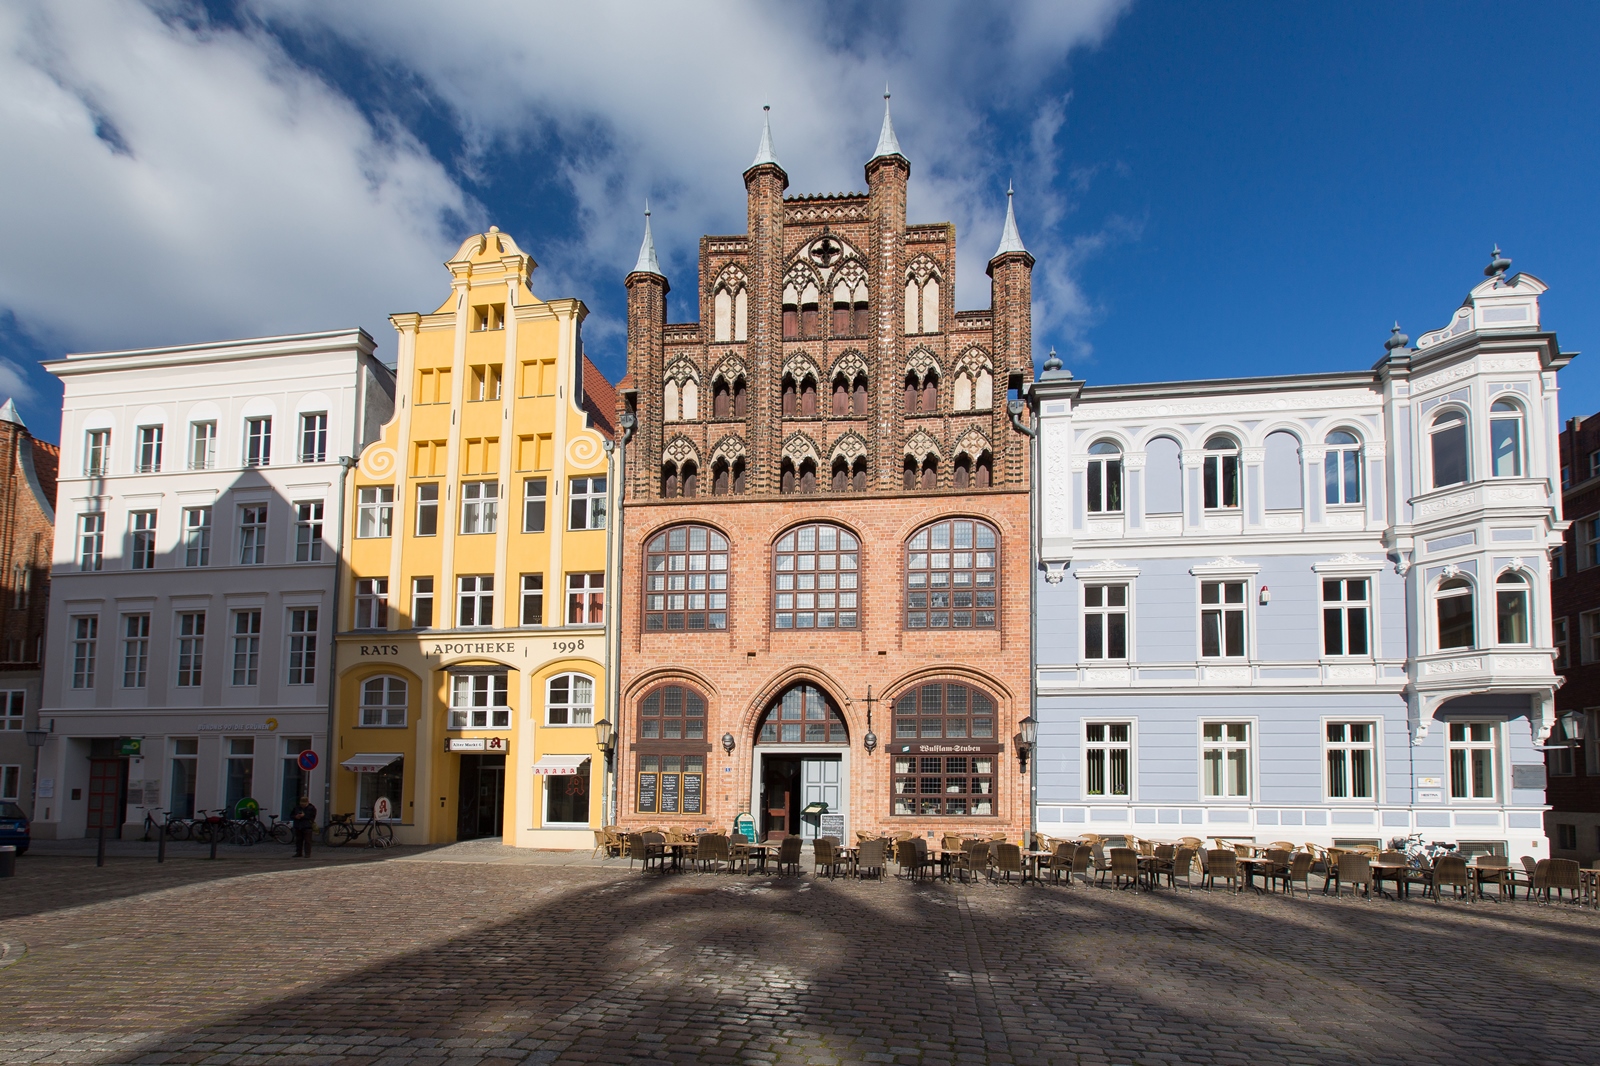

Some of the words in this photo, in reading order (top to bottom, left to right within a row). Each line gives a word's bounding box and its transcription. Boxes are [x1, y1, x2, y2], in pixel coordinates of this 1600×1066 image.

[360, 645, 399, 656] RATS
[433, 642, 515, 654] APOTHEKE
[552, 639, 585, 654] 1998
[245, 722, 270, 730] GRÜNEN
